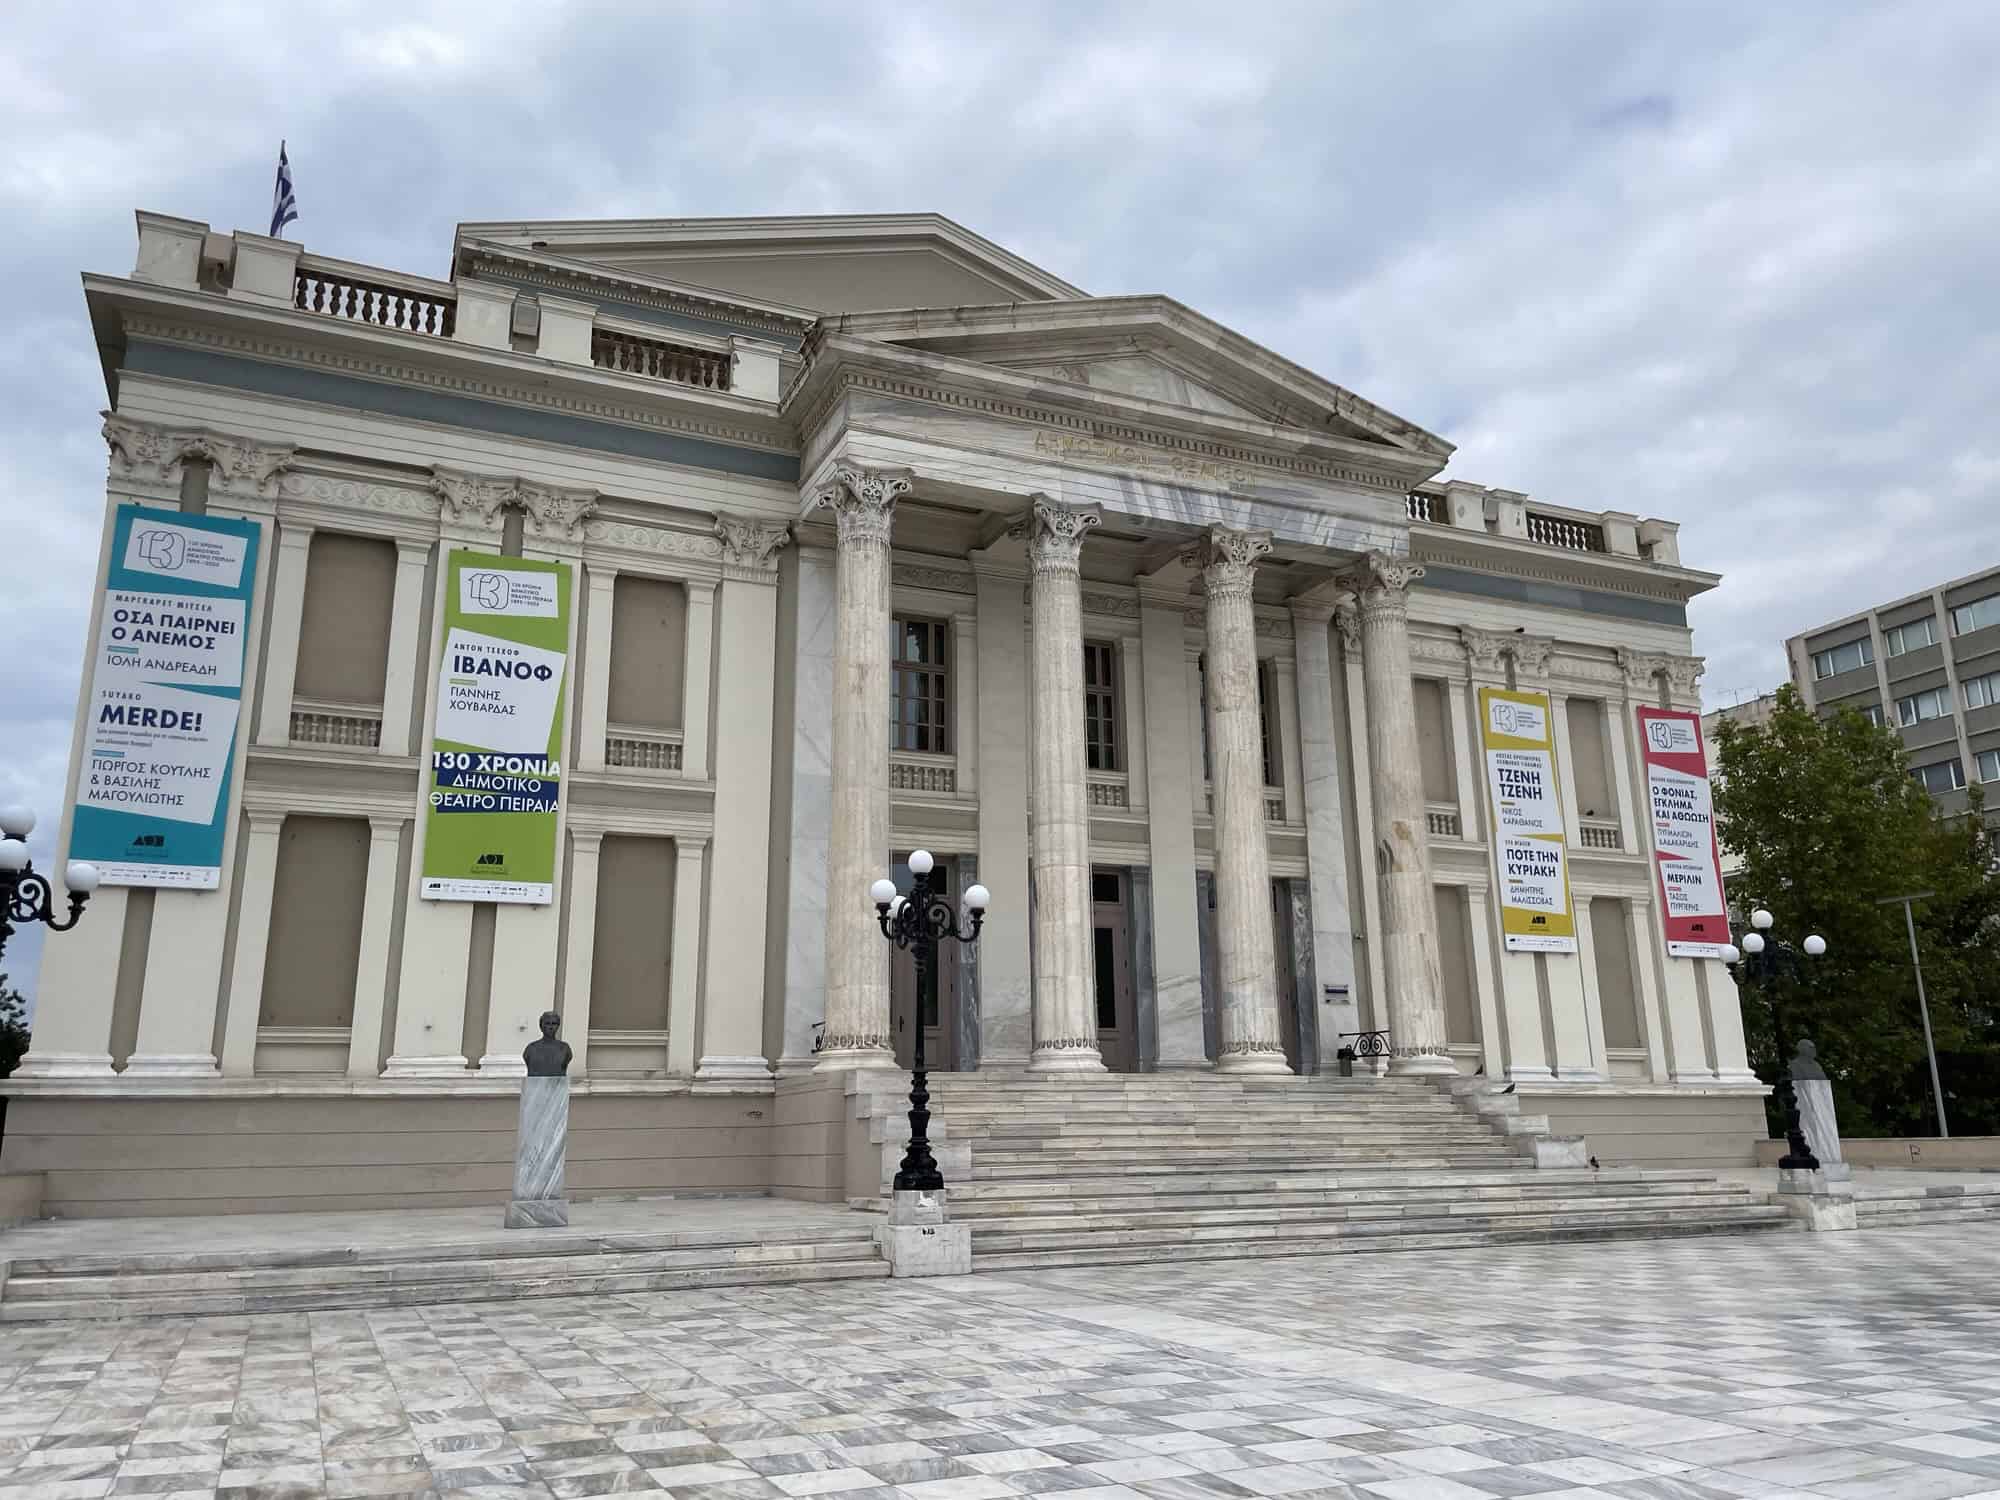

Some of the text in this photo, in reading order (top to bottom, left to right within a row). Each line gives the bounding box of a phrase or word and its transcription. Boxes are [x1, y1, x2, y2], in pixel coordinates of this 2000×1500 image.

[113, 609, 236, 635] ΟΣΑ ΠΑΙΡΝΕΙ
[111, 626, 216, 650] Ο ΑΝΕΜΟΣ
[454, 643, 483, 654] ΑΝΤΟΝ
[107, 655, 217, 676] ΙΟΛΗ ΑΝΔΡΕΑΔΗ
[454, 655, 553, 682] ΙΒΑΝΟΦ
[450, 686, 501, 701] ΓΙΑΝΝΗΣ
[449, 700, 517, 715] ΧΟΥΒΑΡΔΑΣ
[100, 704, 203, 732] MERDE!
[92, 758, 212, 779] ΓΙΩΡΓΟΣ ΚΟΥΤΛΗΣ
[433, 752, 561, 777] 130 ΧΡΟΝΙΑ
[90, 775, 162, 790] & ΒΑΣΙΛΗΣ
[452, 774, 541, 793] ΔΗΜΟΤΙΚΟ
[1498, 768, 1541, 785] ΤΖΕΝΗ
[88, 790, 185, 806] ΜΑΓΟΥΛΙΩΤΗΣ
[1500, 784, 1543, 800] ΤΖΕΝΗ
[1652, 786, 1660, 796] Ο
[429, 792, 561, 814] ΘΕΑΤΡΟ ΠΕΙΡΑΙΑ
[1654, 798, 1693, 810] ΕΓΚΛΗΜΑ
[1656, 810, 1709, 824] ΚΑΙ ΑΘΩΩΣΗ
[1506, 849, 1559, 863] ΠΟΤΕ ΤΗΝ
[1508, 864, 1557, 878] ΚΥΡΙΑΚΗ
[1667, 873, 1702, 885] ΜΕΡΙΛΙΝ
